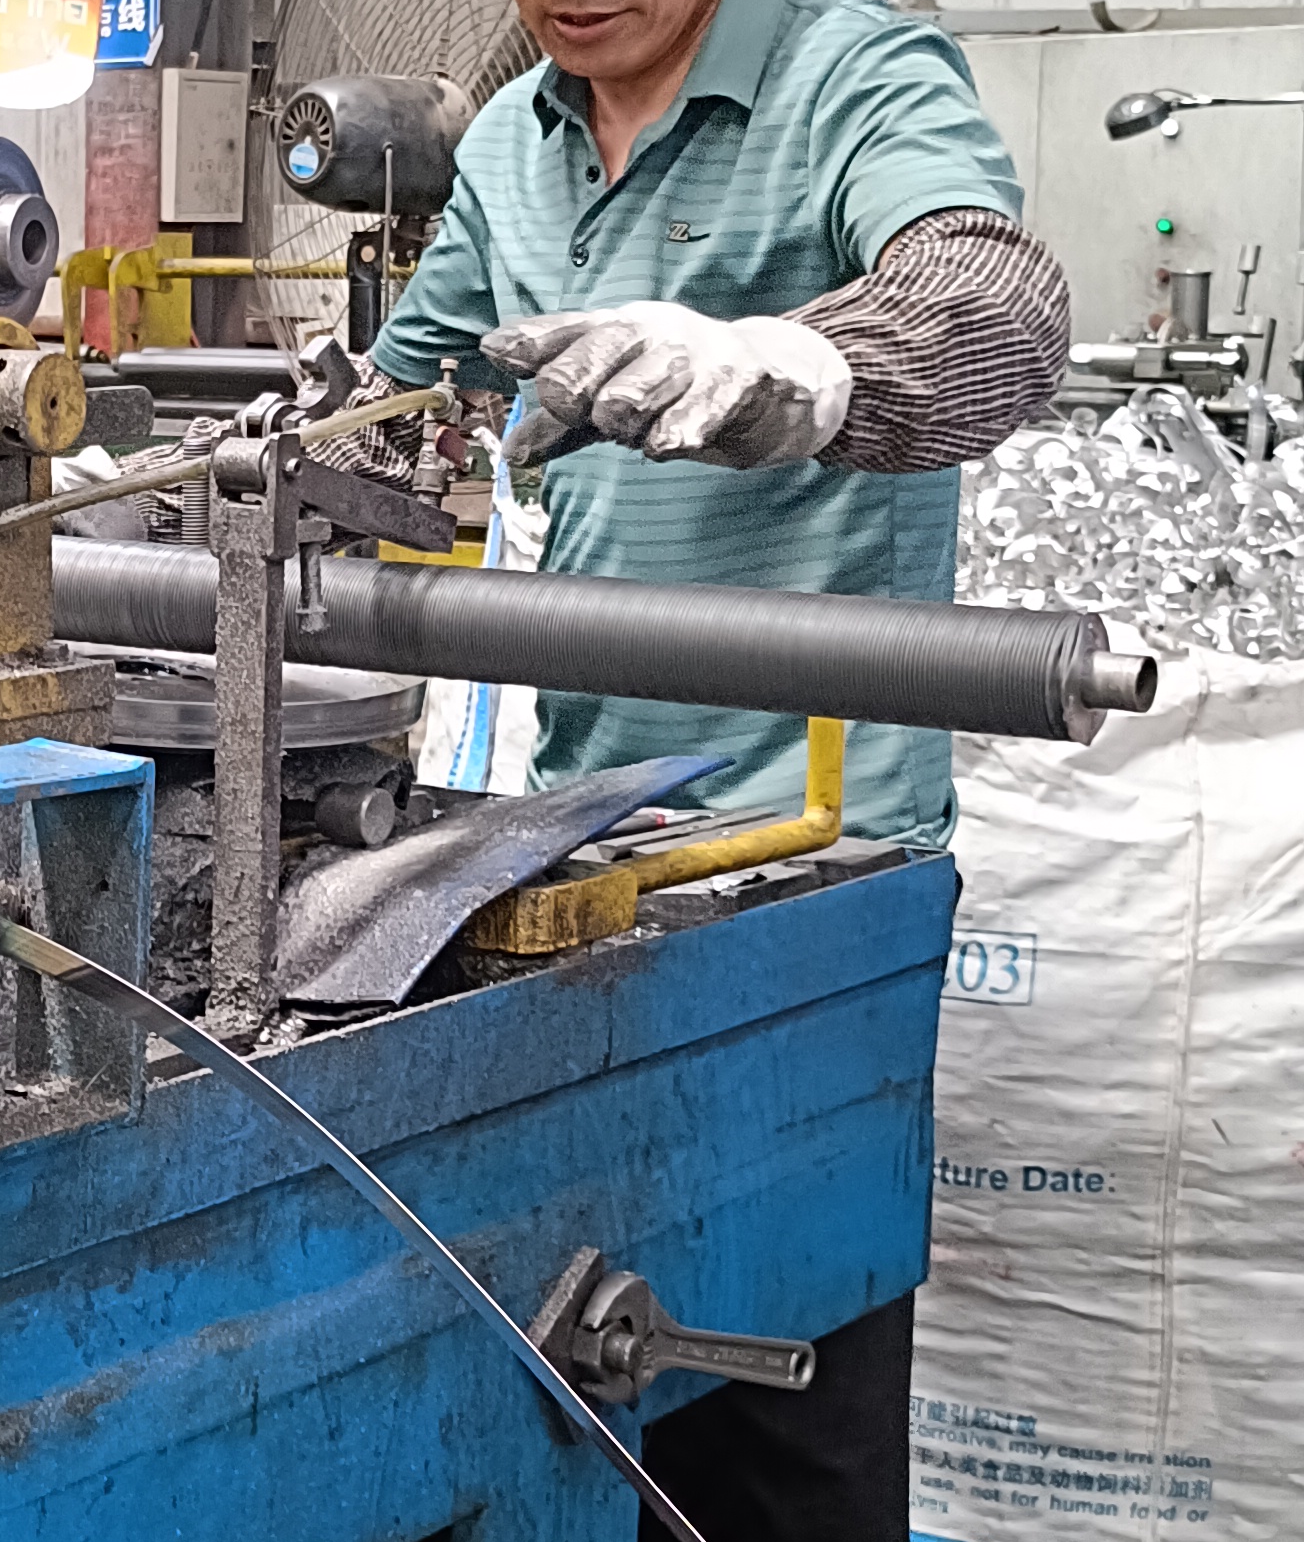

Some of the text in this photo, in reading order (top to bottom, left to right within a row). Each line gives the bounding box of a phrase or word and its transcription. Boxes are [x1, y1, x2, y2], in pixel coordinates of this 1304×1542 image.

[933, 1156, 1116, 1194] ture Date:
[1057, 1443, 1118, 1463] cause
[1011, 1490, 1039, 1508] for
[1050, 1493, 1119, 1518] human
[1186, 1509, 1209, 1523] or
